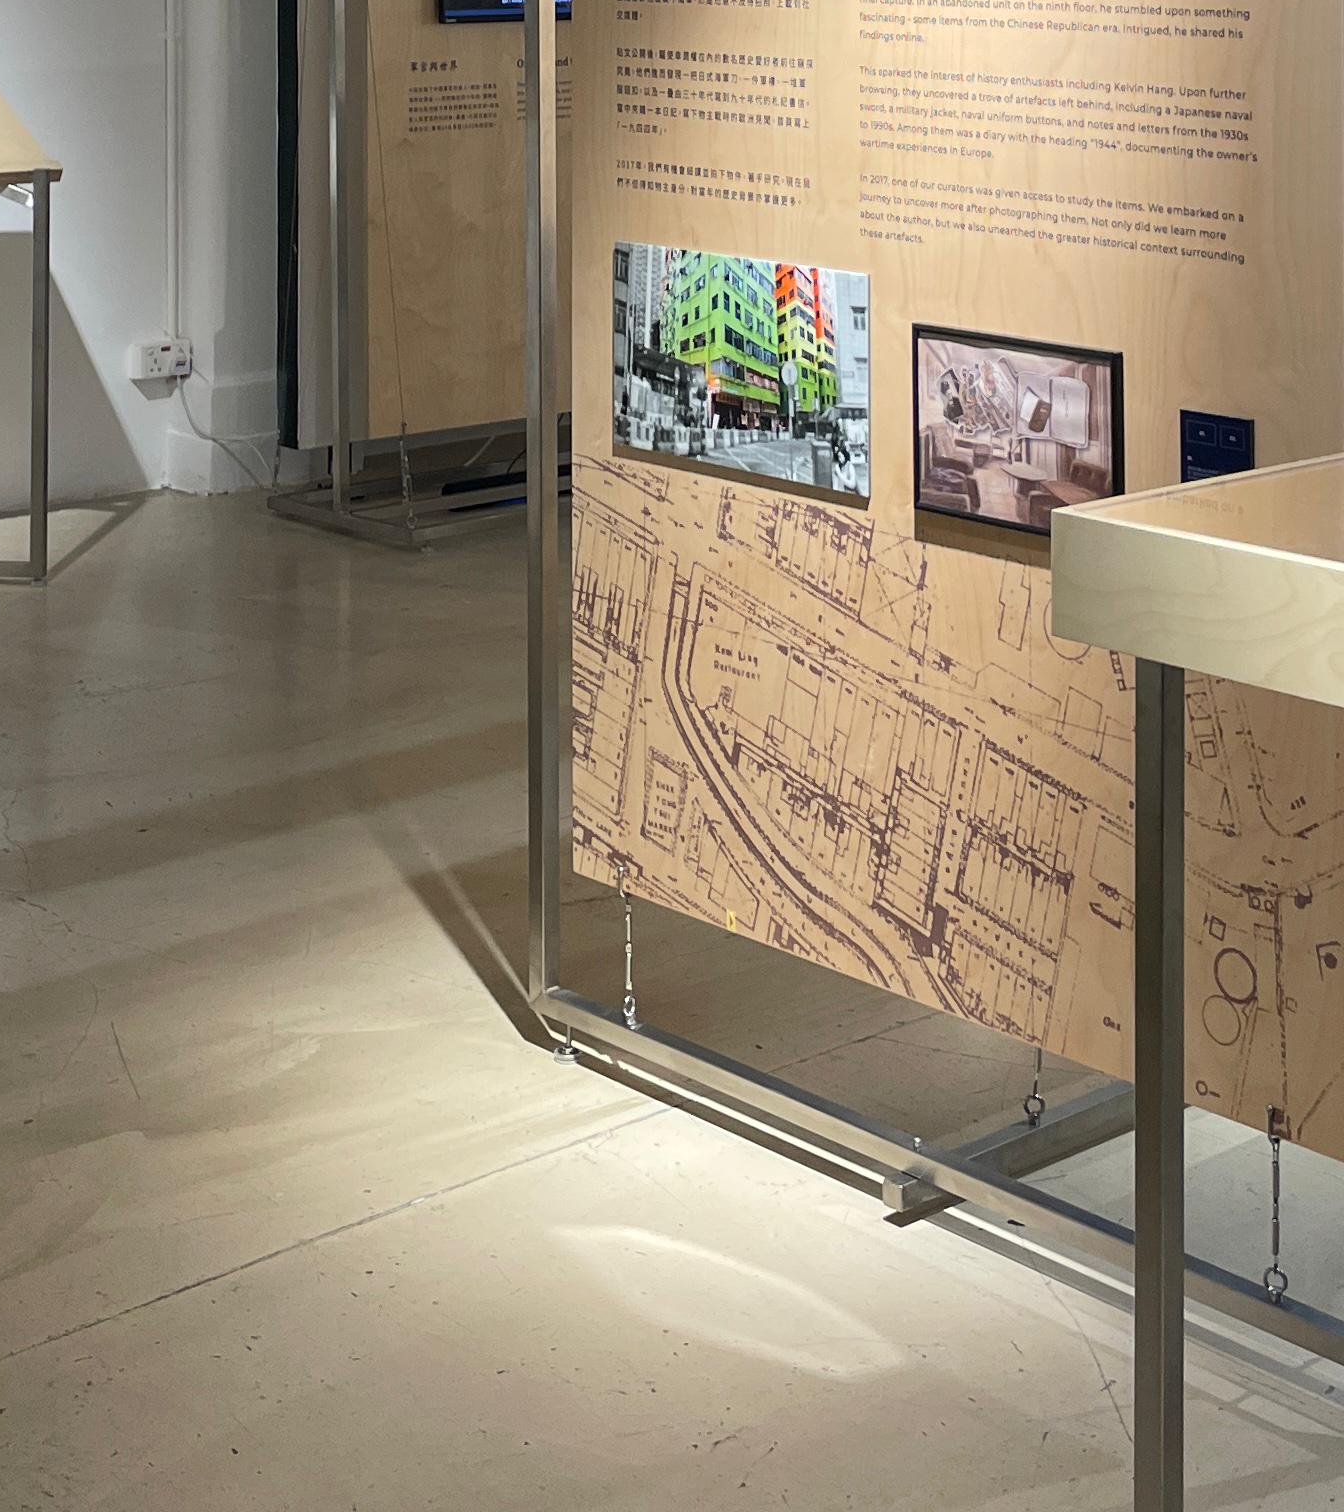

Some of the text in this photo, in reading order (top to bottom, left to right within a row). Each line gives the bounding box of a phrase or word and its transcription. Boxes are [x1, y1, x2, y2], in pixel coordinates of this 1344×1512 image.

[1012, 1, 1025, 10] on
[1027, 0, 1043, 10] the
[1045, 0, 1070, 11] ninth
[1072, 1, 1097, 15] floor,
[1099, 2, 1112, 13] he
[1114, 3, 1162, 15] stumbled
[1164, 7, 1191, 19] upon
[1193, 6, 1250, 22] something
[859, 12, 905, 27] fascinating
[912, 16, 936, 25] some
[938, 15, 963, 26] items
[964, 16, 987, 27] from
[989, 17, 1005, 28] the
[1006, 17, 1044, 30] Chinese
[1046, 19, 1099, 35] Republican
[1102, 24, 1120, 33] era.
[1122, 22, 1171, 38] Intrigued,
[1174, 25, 1187, 36] he
[1189, 26, 1225, 38] shared
[1227, 28, 1243, 39] his
[859, 29, 924, 44] findings online.
[859, 65, 1245, 100] This sparked the interest of history enthusiasts including Kelvin Hang. Upon further
[859, 84, 1252, 120] browsing, they uncovered a trove of artefacts left behind, including a Japanese naval
[714, 660, 760, 681] Restaurant
